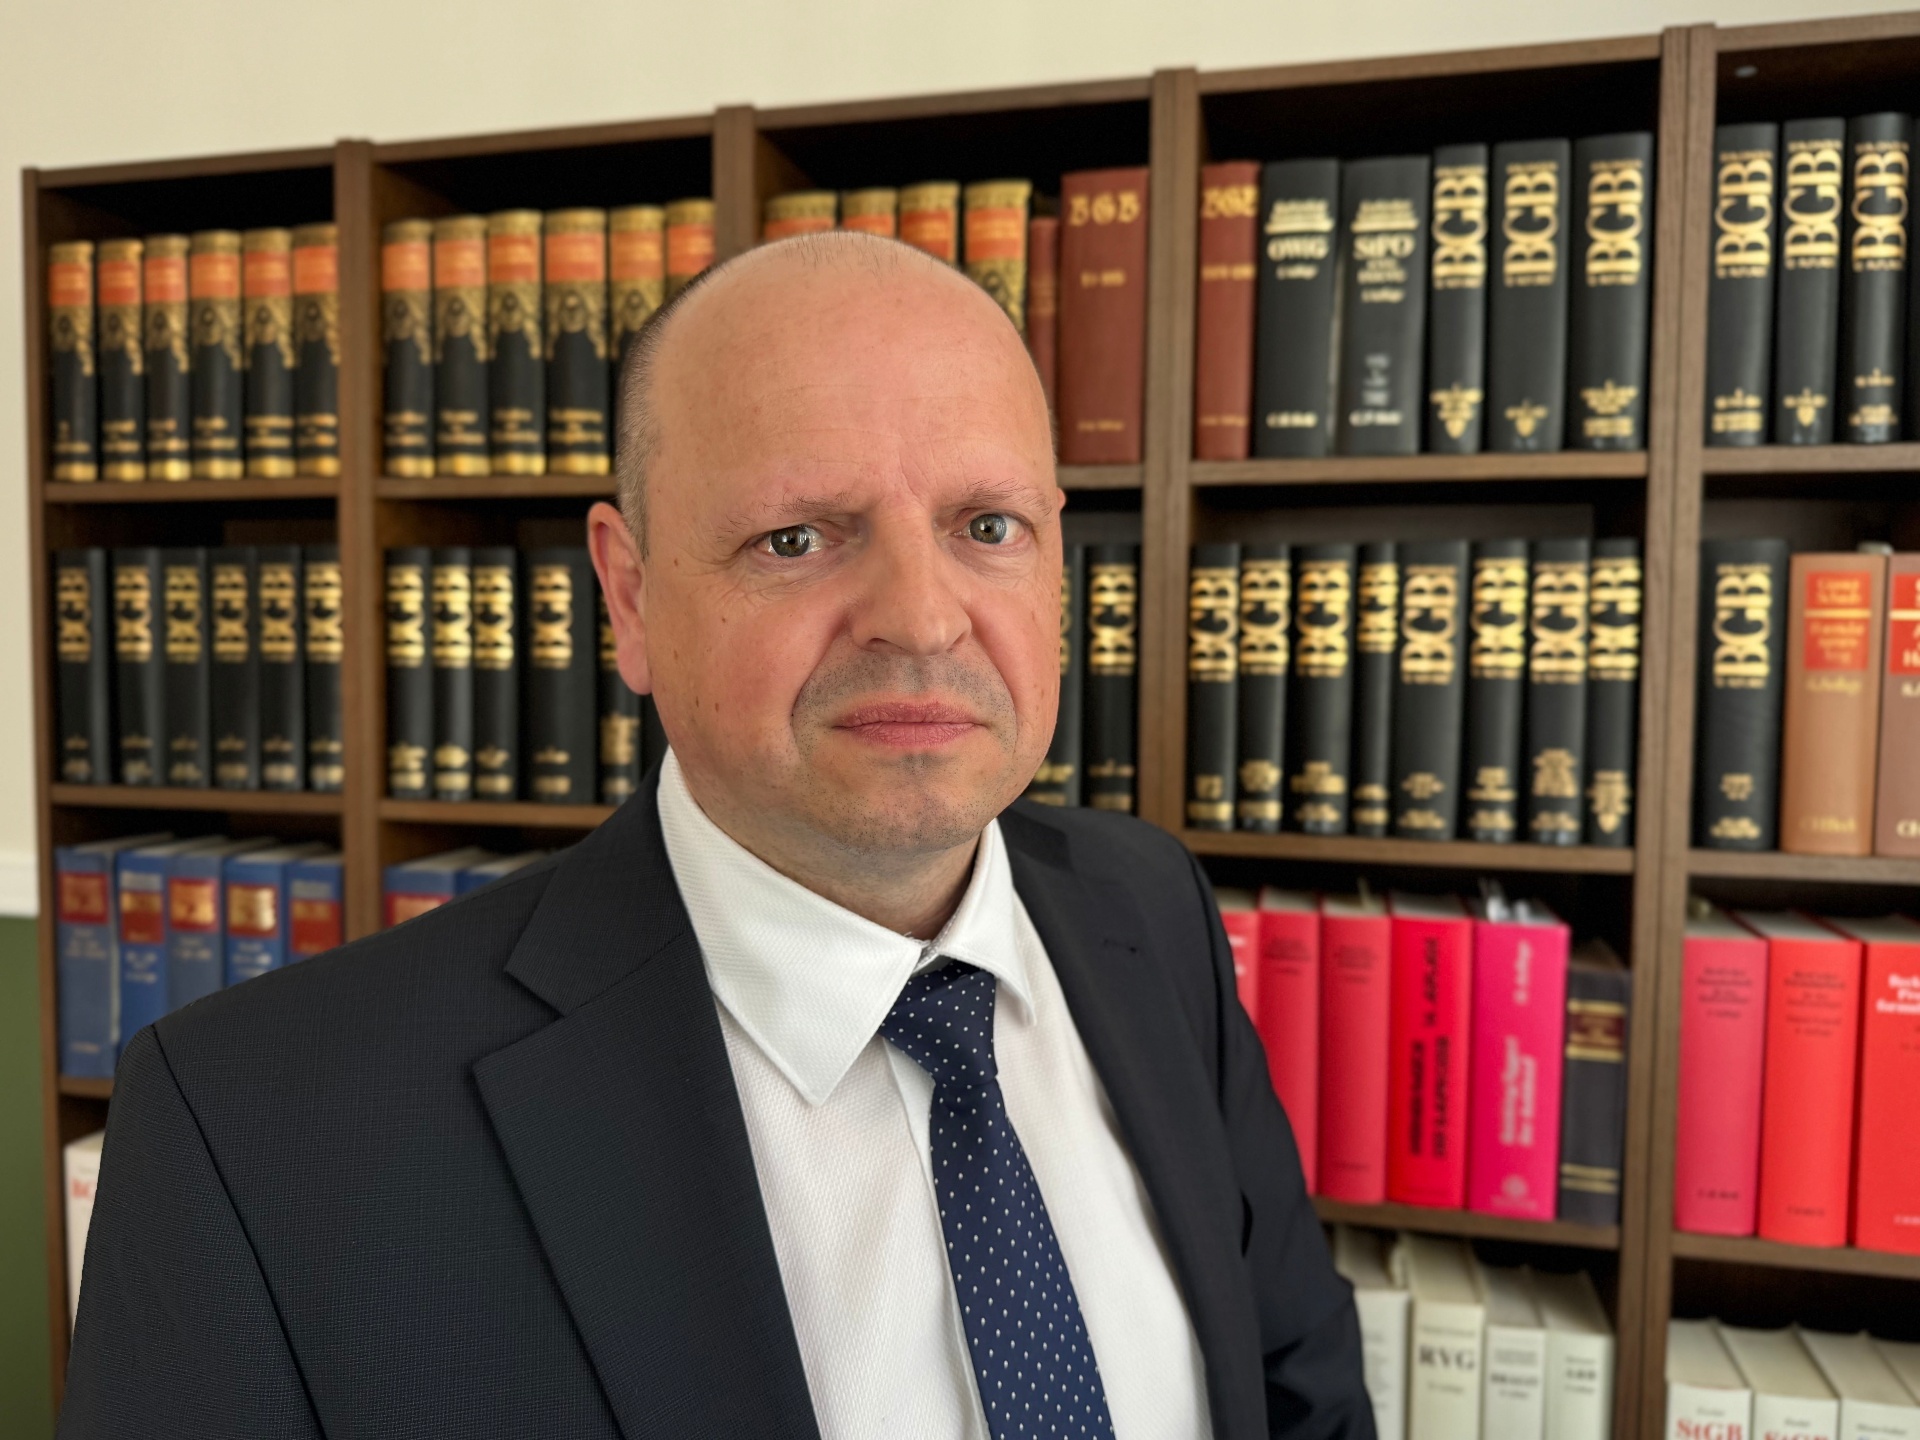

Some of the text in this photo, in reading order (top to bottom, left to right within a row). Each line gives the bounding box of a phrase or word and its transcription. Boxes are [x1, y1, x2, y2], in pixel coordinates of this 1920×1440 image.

[1433, 174, 1486, 276] BGB
[1502, 170, 1558, 276] BGB
[1586, 169, 1643, 275] BGB
[1715, 159, 1773, 266] BGB
[1783, 148, 1842, 256] BGB
[1852, 150, 1909, 260] BGB
[1089, 573, 1137, 666] BGB
[1189, 577, 1238, 673] BGB
[1239, 568, 1290, 666] BGB
[1296, 567, 1350, 667] BGB
[1400, 572, 1458, 674] BGB
[1470, 566, 1529, 668] BGB
[1530, 570, 1589, 673] BGB
[1713, 572, 1773, 677] BGB
[1418, 1345, 1475, 1371] RVG
